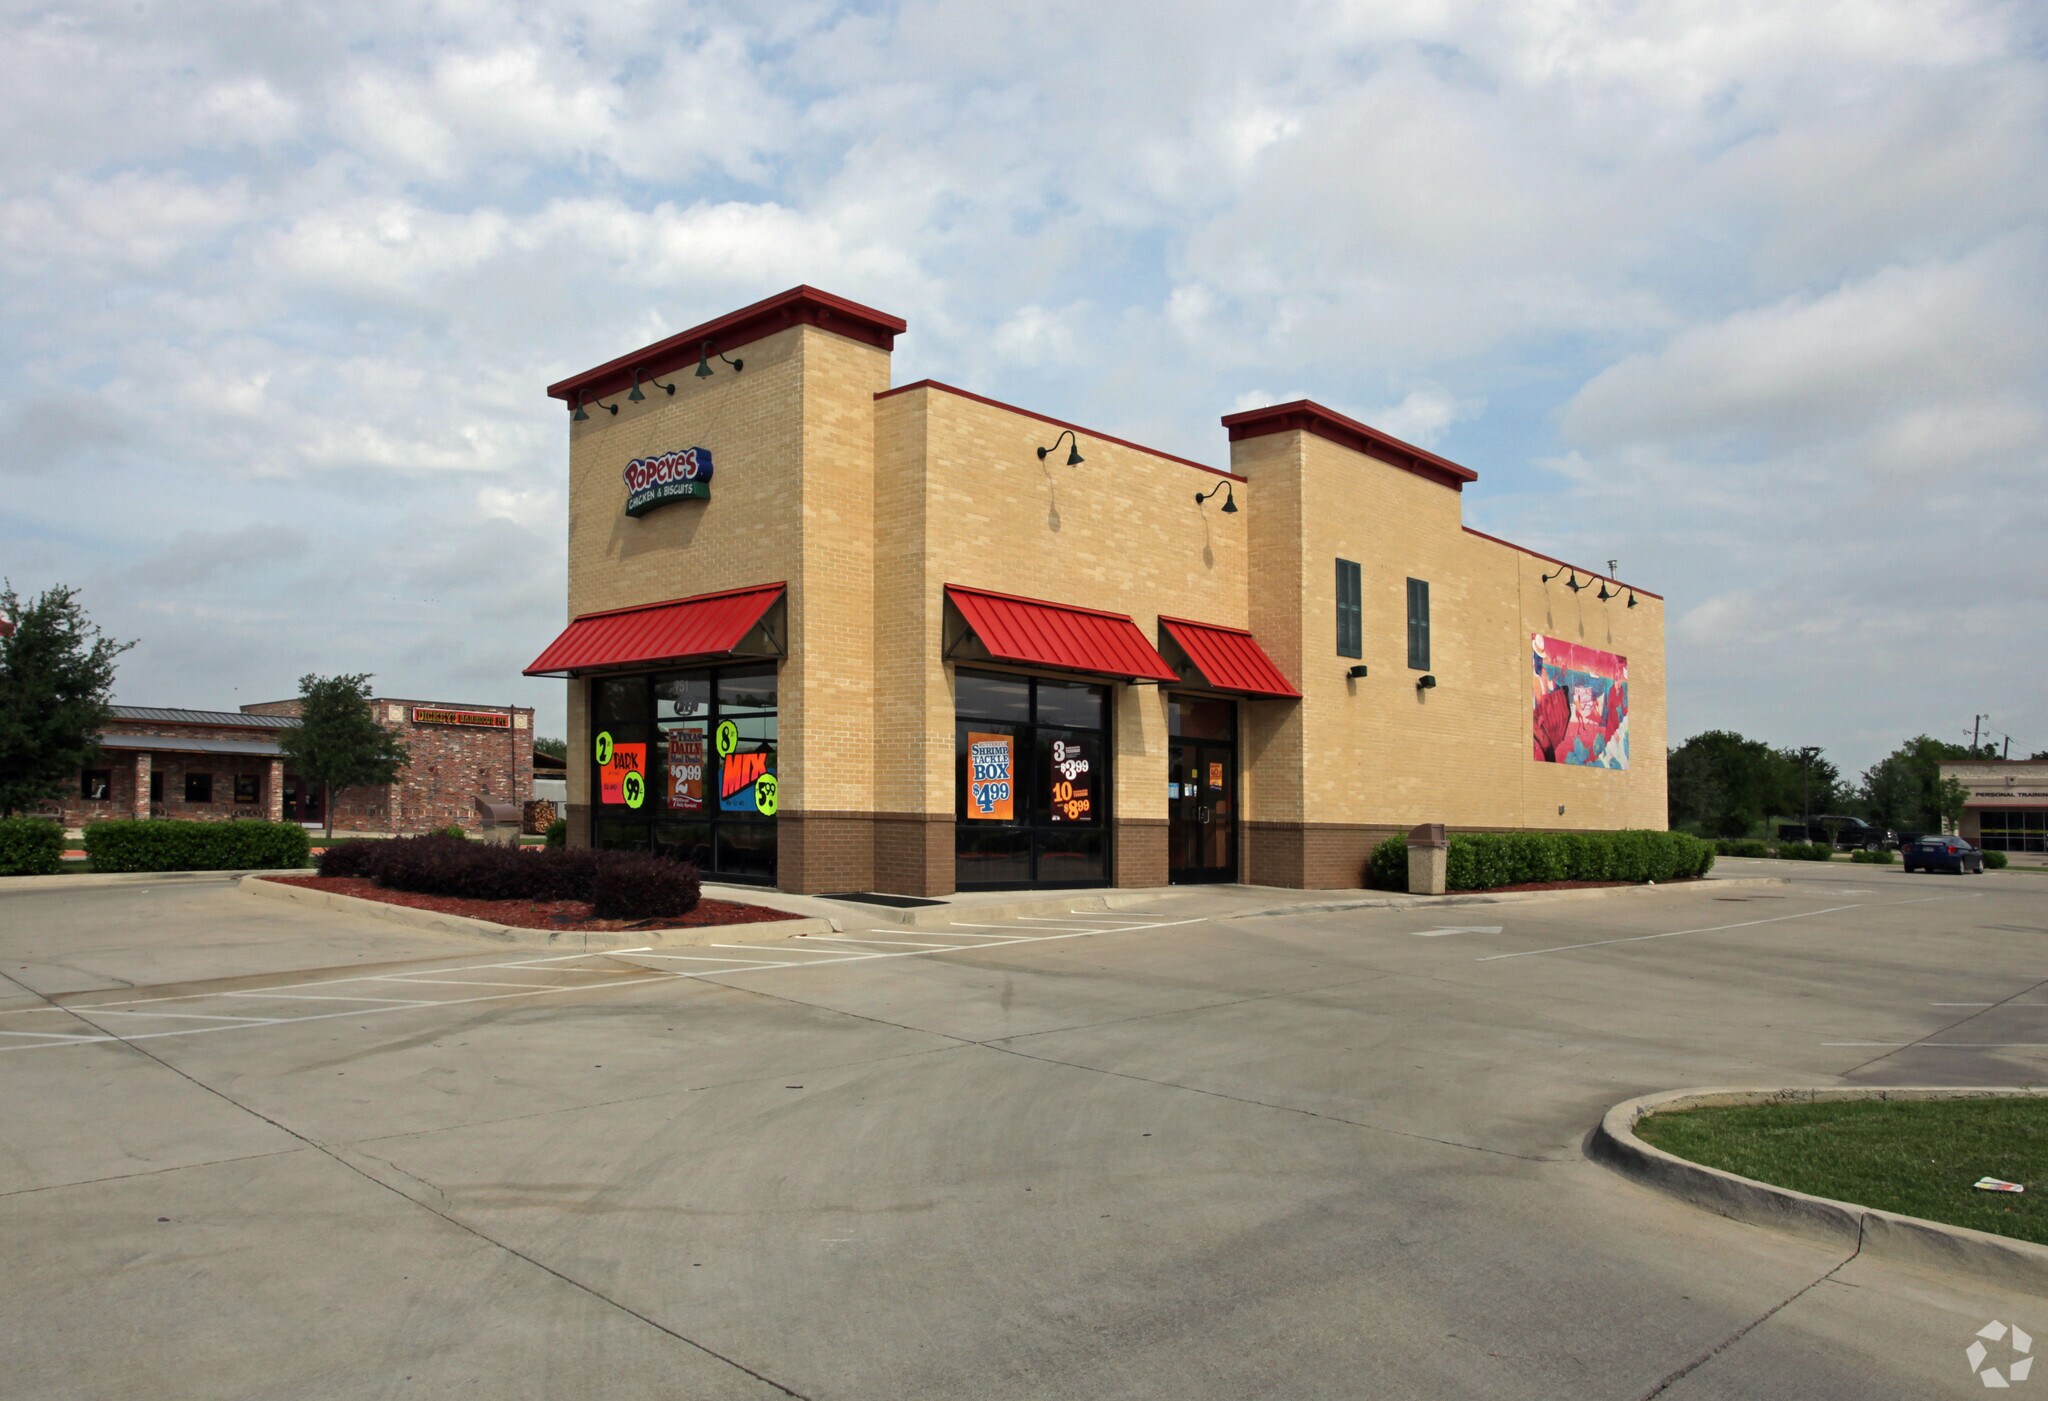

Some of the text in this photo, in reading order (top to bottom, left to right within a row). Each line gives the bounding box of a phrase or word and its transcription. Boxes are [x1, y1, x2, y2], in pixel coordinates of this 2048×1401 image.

[628, 491, 654, 509] CHICKEN
[664, 484, 693, 496] BISCUITS
[677, 732, 702, 742] TEXAS
[721, 726, 730, 751] 8
[599, 736, 607, 762] 2
[671, 741, 702, 755] DAILY
[972, 745, 1009, 755] SHRIMP
[1054, 741, 1065, 761] 3
[613, 752, 638, 770] DARK
[973, 755, 1009, 764] TACKLE
[722, 752, 767, 799] MIX
[974, 764, 1009, 780] BOX
[1053, 781, 1072, 802] 10
